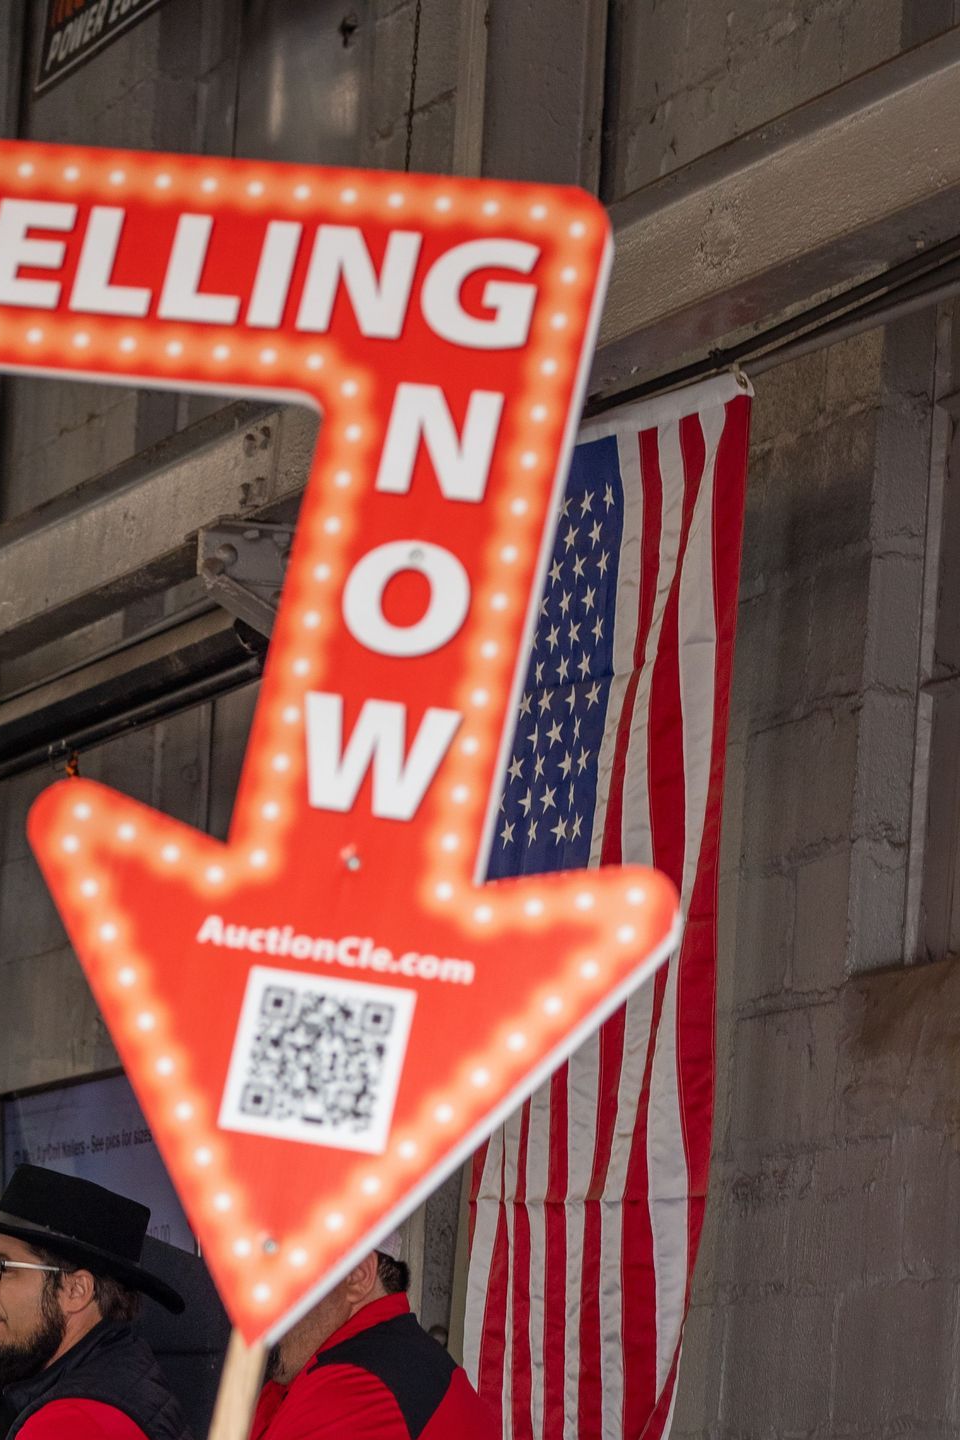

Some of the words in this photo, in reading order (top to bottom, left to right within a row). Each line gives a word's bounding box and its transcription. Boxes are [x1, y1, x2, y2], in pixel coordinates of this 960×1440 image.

[45, 0, 107, 71] POWER
[304, 381, 505, 821] NOW
[196, 914, 475, 985] AuctionCle.com
